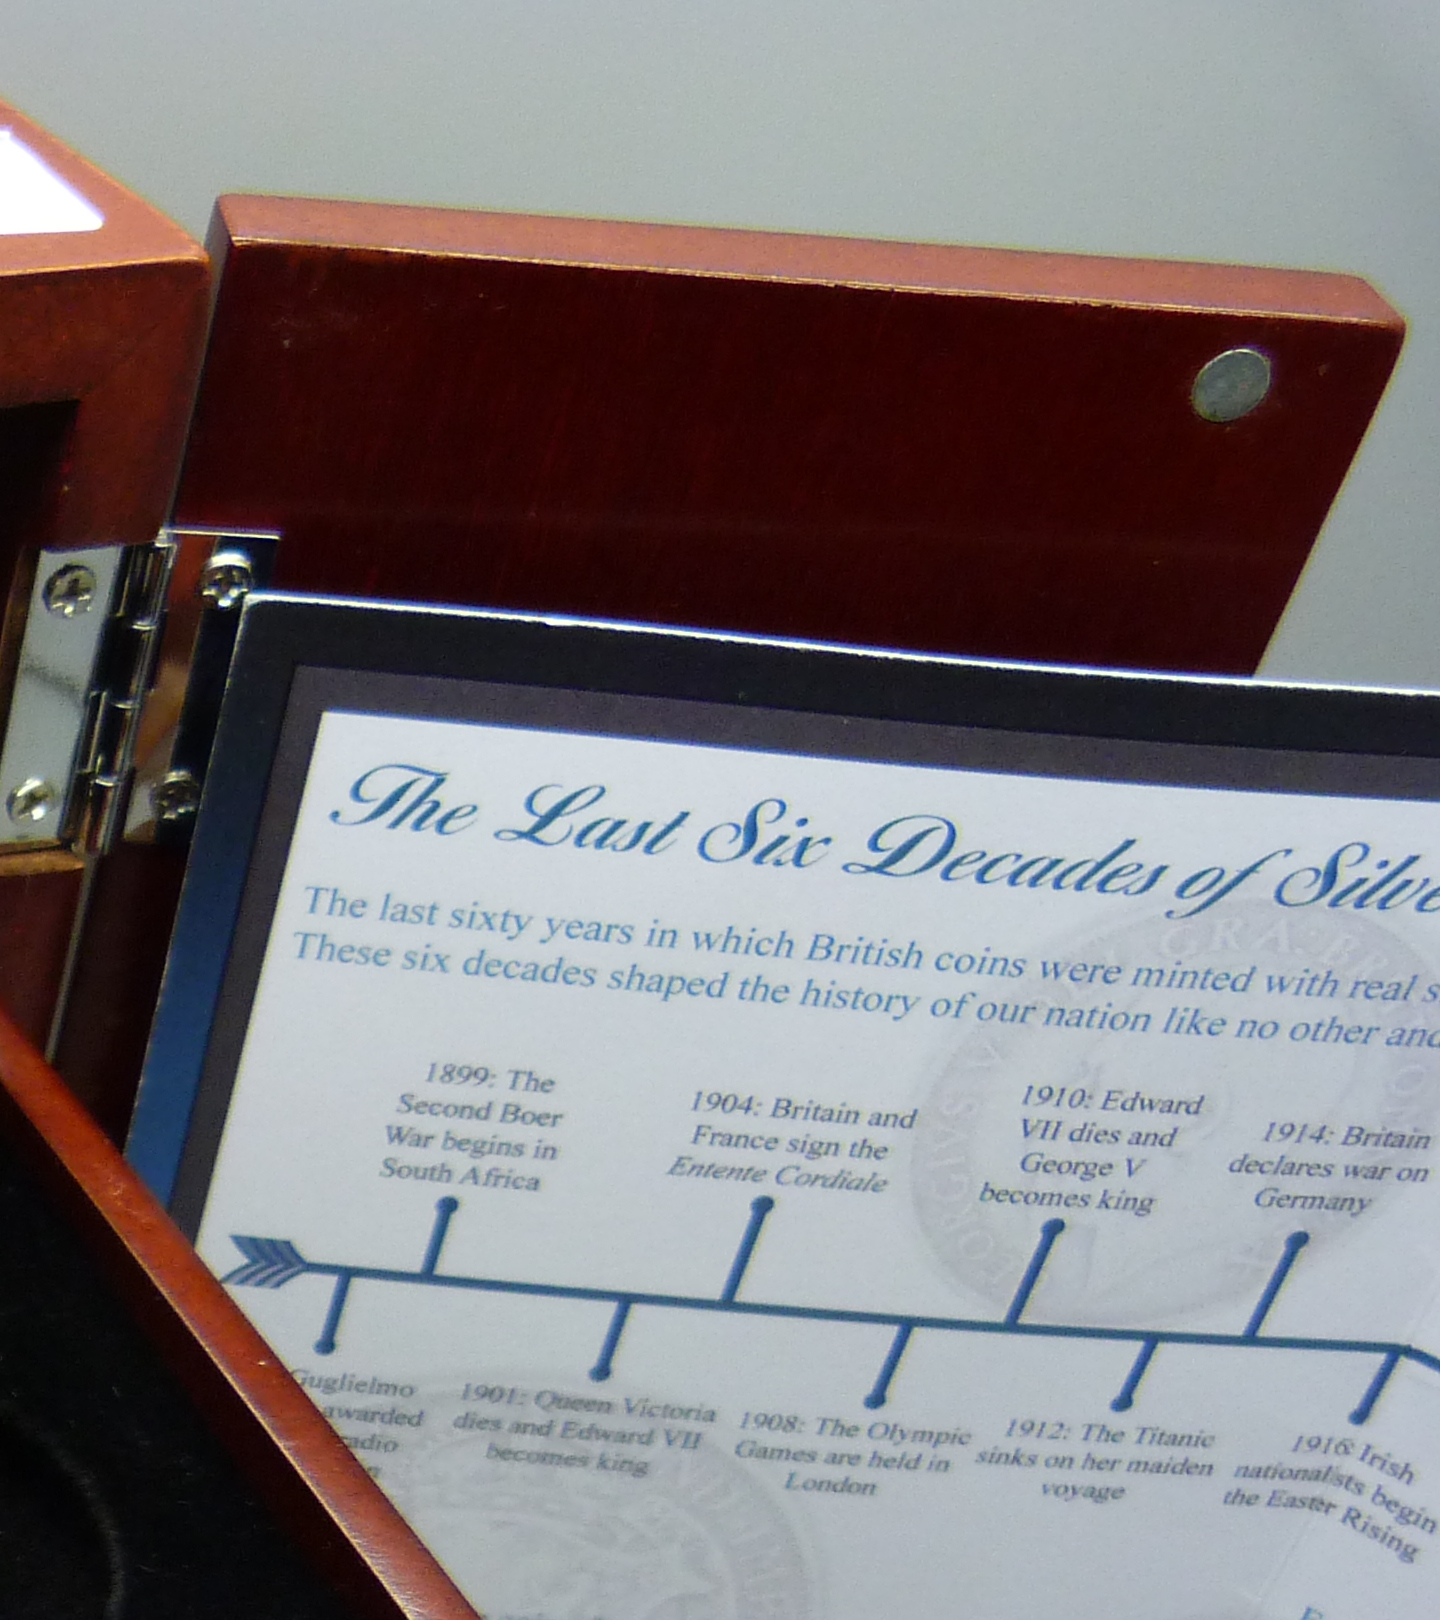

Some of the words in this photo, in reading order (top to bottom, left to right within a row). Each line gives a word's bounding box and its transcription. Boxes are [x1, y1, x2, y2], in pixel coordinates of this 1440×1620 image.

[329, 762, 478, 837] The
[494, 784, 690, 857] Last
[697, 797, 832, 869] Six
[841, 815, 1171, 896] Decades
[1164, 848, 1293, 919] of
[305, 885, 369, 919] The
[379, 892, 440, 926] last
[448, 901, 534, 941] sixty
[539, 917, 635, 945] years
[646, 918, 679, 949] in
[692, 925, 795, 959] which
[805, 933, 924, 970] British
[934, 947, 1028, 978] coins
[1041, 960, 1124, 985] were
[1131, 961, 1258, 993] minted
[1267, 968, 1340, 998] with
[1348, 974, 1419, 1001] real
[294, 931, 393, 967] These
[401, 943, 451, 974] six
[462, 948, 598, 988] decades
[606, 963, 731, 1002] shaped
[738, 974, 791, 1005] the
[799, 978, 922, 1022] history
[930, 991, 978, 1019] of
[976, 1002, 1038, 1024] our
[1043, 1002, 1153, 1033] nation
[1162, 1006, 1228, 1037] like
[1235, 1019, 1281, 1040] no
[1289, 1016, 1381, 1045] other
[427, 1063, 496, 1087] 1899:
[509, 1070, 556, 1093] The
[397, 1094, 493, 1120] Second
[500, 1104, 564, 1127] Boer
[693, 1091, 762, 1115] 1904:
[771, 1098, 860, 1124] Britain
[868, 1109, 918, 1128] and
[1023, 1085, 1093, 1108] 1910:
[1101, 1090, 1205, 1115] Edward
[386, 1125, 436, 1148] War
[442, 1131, 525, 1158] begins
[534, 1140, 558, 1160] in
[692, 1125, 779, 1151] France
[787, 1135, 840, 1159] sign
[849, 1139, 888, 1160] the
[1023, 1119, 1062, 1140] VII
[1069, 1123, 1121, 1143] dies
[1128, 1128, 1178, 1147] and
[1264, 1122, 1334, 1144] 1914:
[1341, 1126, 1431, 1149] Britain
[380, 1158, 453, 1182] South
[459, 1167, 540, 1191] Africa
[666, 1156, 768, 1182] Entente
[776, 1166, 888, 1193] Cordiale
[1020, 1153, 1113, 1181] George
[1127, 1158, 1146, 1177] V
[1229, 1154, 1335, 1177] declares
[1345, 1166, 1392, 1180] war
[1396, 1168, 1429, 1182] on
[980, 1182, 1091, 1207] becomes
[1097, 1190, 1156, 1217] king
[1255, 1188, 1372, 1217] Germany
[462, 1384, 527, 1404] 1901:
[535, 1390, 614, 1413] Queen
[625, 1398, 717, 1423] Victoria
[453, 1413, 502, 1431] dies
[508, 1421, 554, 1436] and
[560, 1422, 655, 1446] Edward
[665, 1430, 702, 1450] VII
[741, 1412, 804, 1432] 1908:
[818, 1418, 860, 1438] The
[868, 1423, 972, 1447] Olympic
[1006, 1419, 1070, 1439] 1912:
[1083, 1424, 1125, 1443] The
[1136, 1427, 1215, 1448] Titanic
[486, 1444, 590, 1467] becomes
[596, 1454, 650, 1478] king
[736, 1441, 818, 1462] Games
[824, 1453, 862, 1466] are
[868, 1451, 922, 1470] held
[927, 1460, 951, 1472] in
[975, 1447, 1038, 1466] sinks
[1045, 1456, 1074, 1469] on
[1082, 1453, 1121, 1471] her
[1127, 1459, 1214, 1476] maiden
[1359, 1444, 1414, 1485] Irish
[785, 1473, 878, 1495] London
[1043, 1484, 1125, 1503] voyage
[1234, 1463, 1365, 1495] nationalists
[1372, 1485, 1440, 1534] begin
[1223, 1489, 1260, 1506] the
[1267, 1491, 1337, 1515] Easter
[1341, 1507, 1420, 1562] Rising
